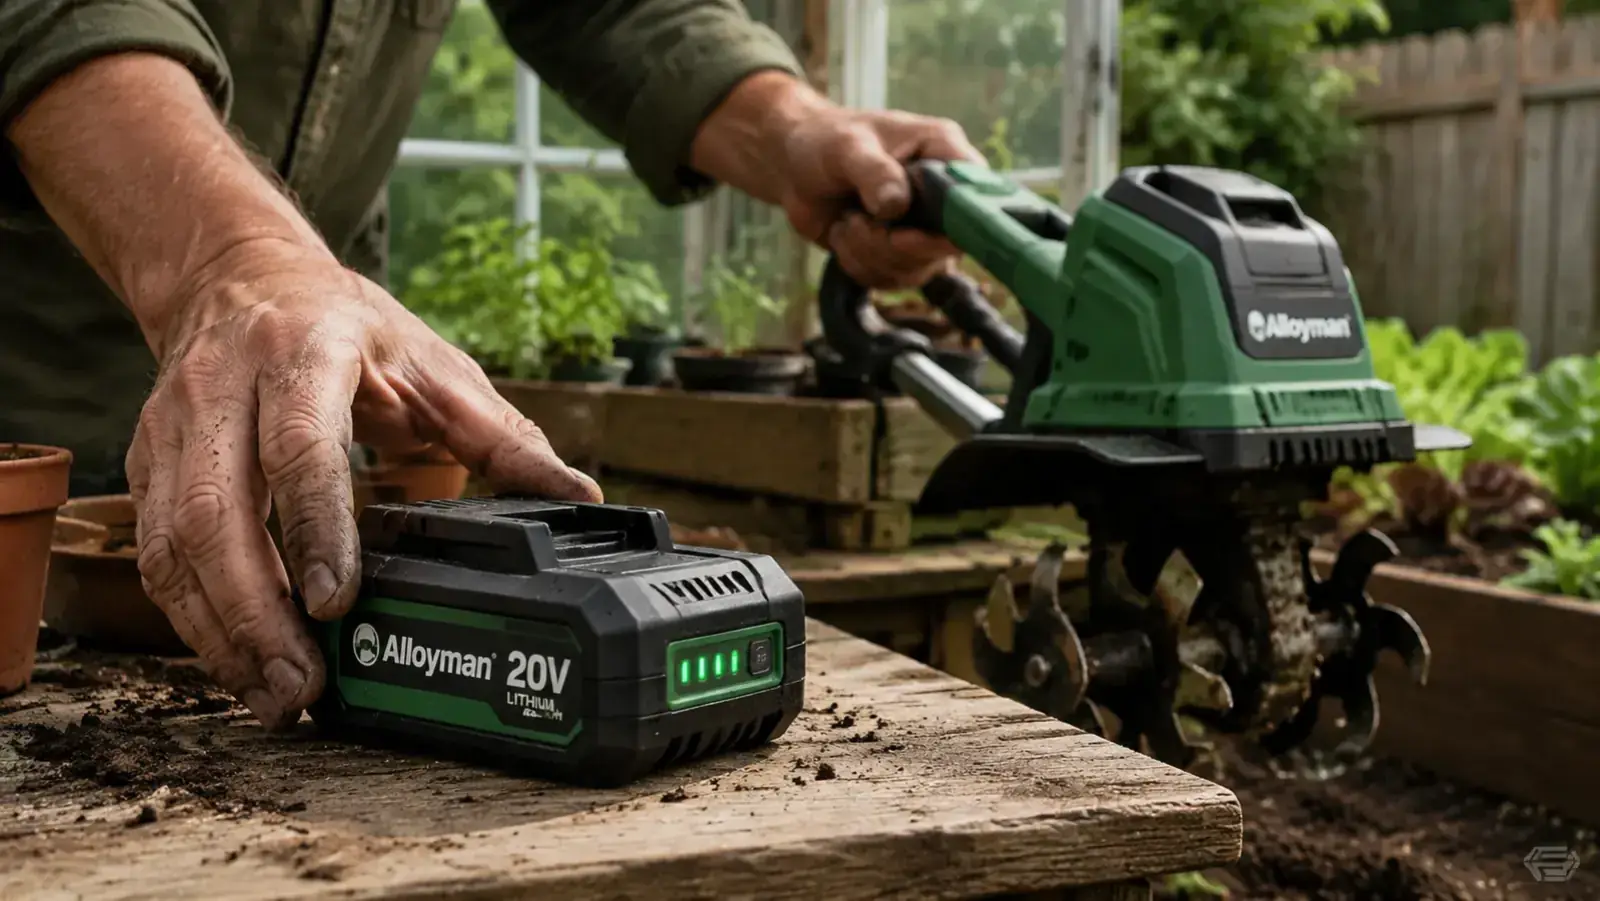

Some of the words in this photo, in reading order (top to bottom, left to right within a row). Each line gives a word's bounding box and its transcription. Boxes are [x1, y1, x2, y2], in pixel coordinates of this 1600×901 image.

[1265, 313, 1351, 343] Alloyman
[382, 634, 492, 681] Alloyman
[506, 650, 571, 695] 20V
[506, 691, 555, 712] LITHIUM
